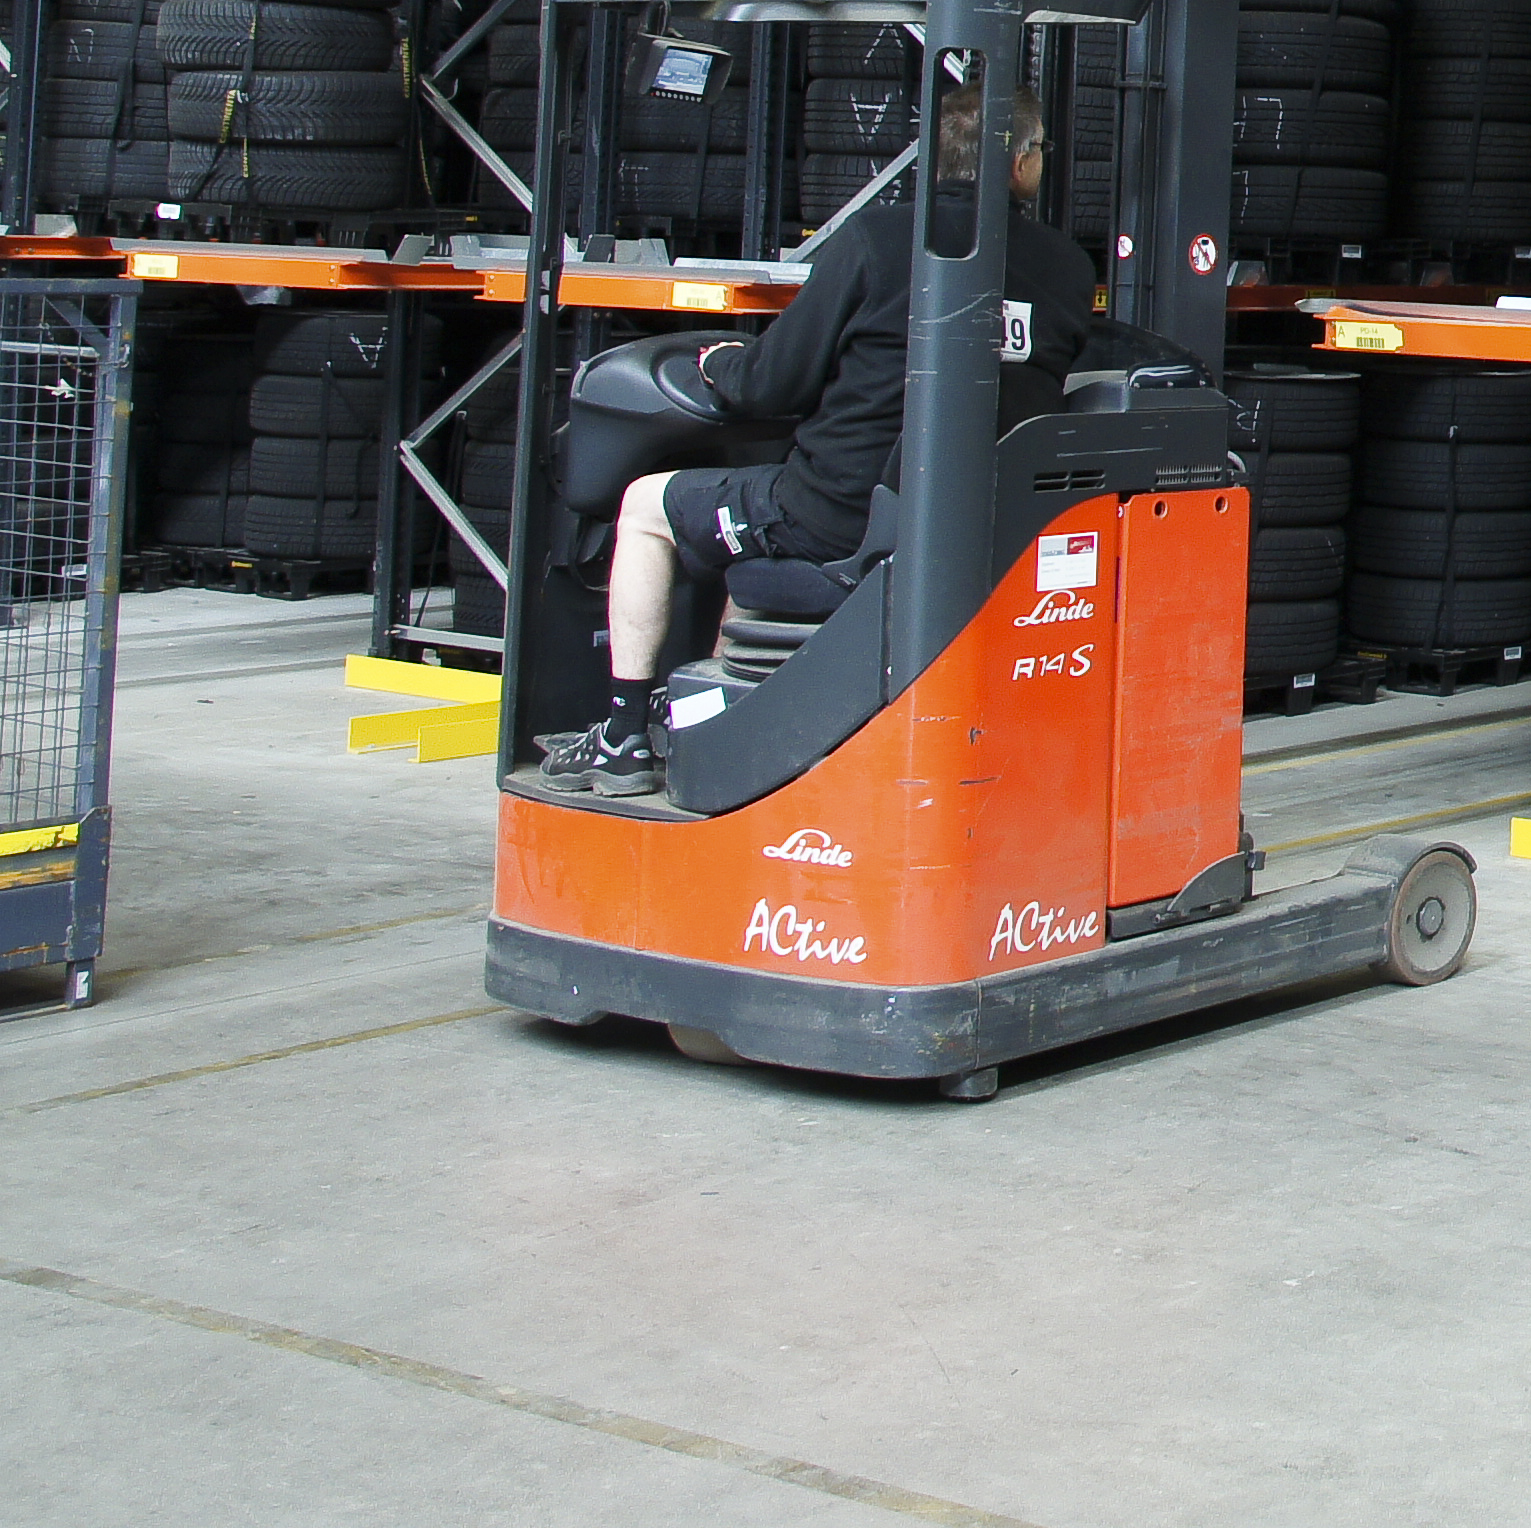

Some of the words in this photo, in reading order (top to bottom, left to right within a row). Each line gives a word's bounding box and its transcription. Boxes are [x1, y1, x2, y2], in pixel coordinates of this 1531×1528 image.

[1338, 325, 1347, 338] A
[1012, 589, 1095, 628] Linde
[762, 828, 854, 868] Linde
[742, 897, 869, 965] ACtive
[987, 900, 1100, 963] ACtive
